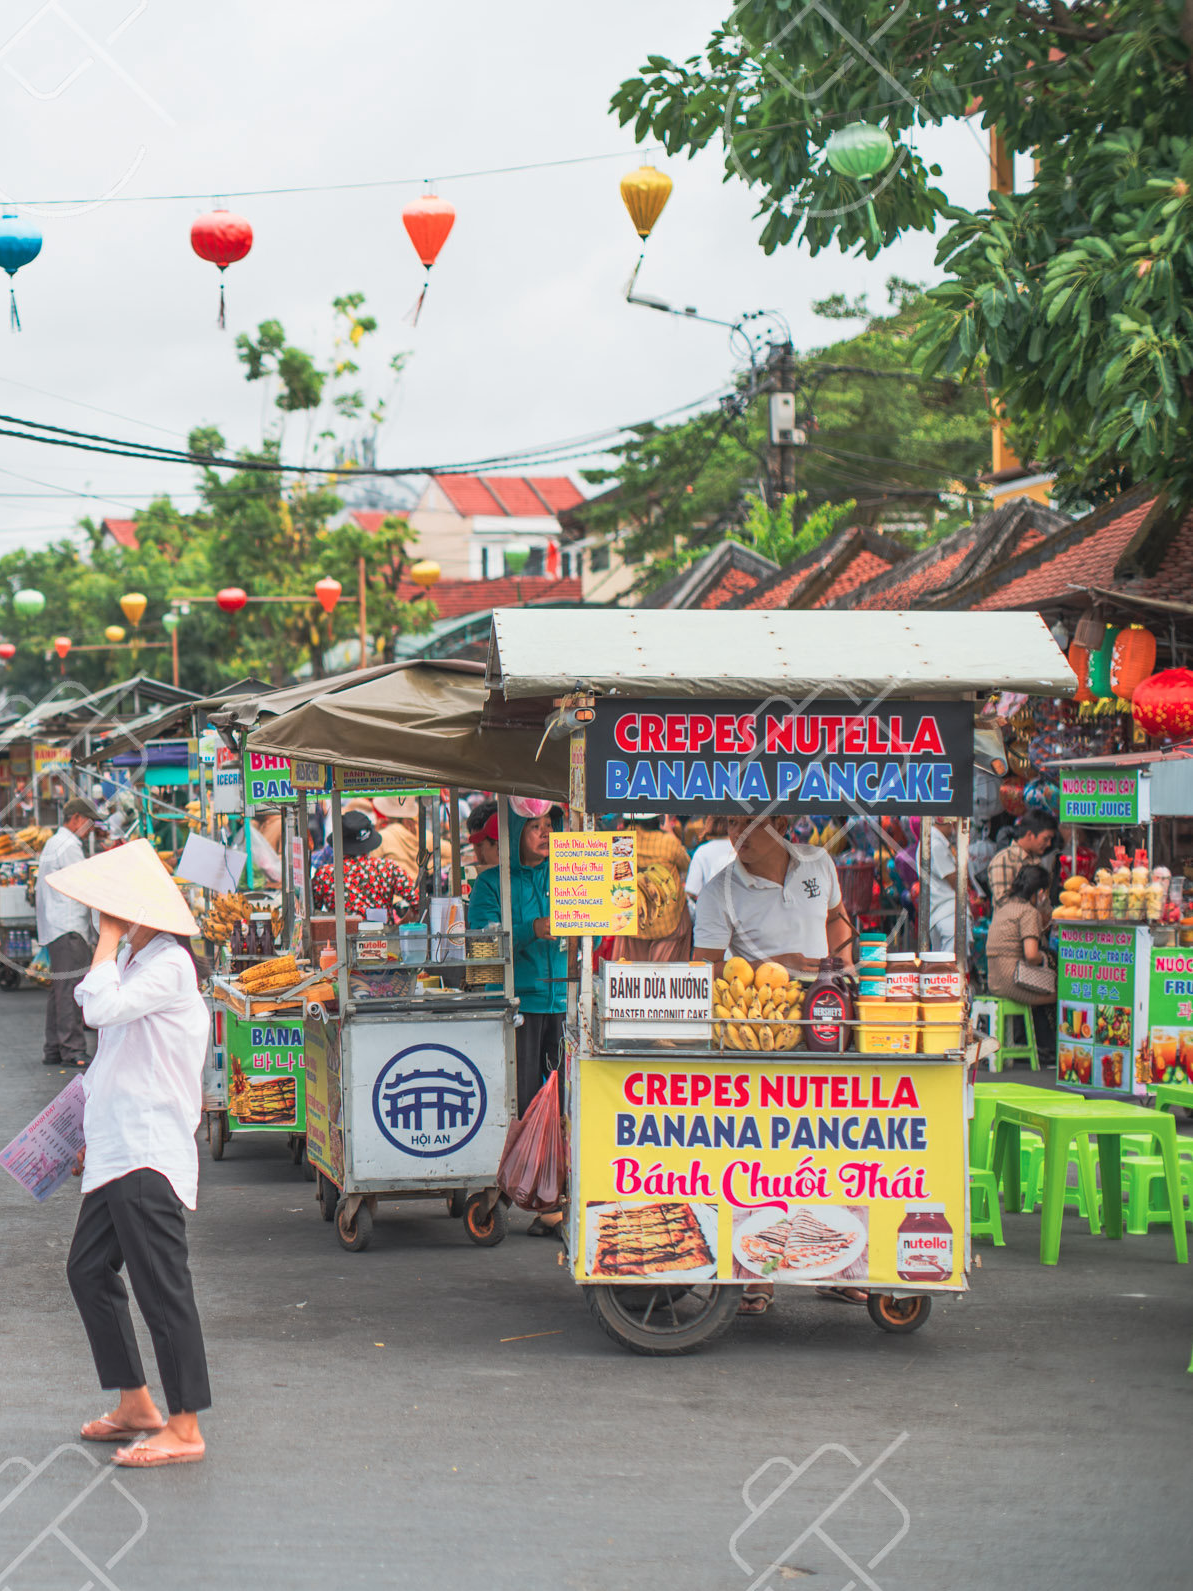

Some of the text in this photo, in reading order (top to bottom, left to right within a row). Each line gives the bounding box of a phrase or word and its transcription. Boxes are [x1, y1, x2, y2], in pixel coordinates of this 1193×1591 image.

[614, 713, 946, 755] CREPES NUTELLA
[606, 760, 771, 800] BANANA
[777, 762, 954, 802] PANCAKE
[1067, 801, 1131, 816] FRUIT JUICE
[553, 839, 570, 849] Bánh
[554, 862, 570, 872] Bánh
[554, 887, 570, 896] Bánh
[554, 910, 570, 920] Bánh
[358, 940, 387, 949] nutella
[887, 972, 919, 985] nutella
[924, 972, 959, 985] nutella
[1065, 963, 1127, 982] FRUIT JUICE
[610, 971, 709, 1000] BÁNH DỪA NƯỚNG
[610, 1008, 708, 1019] TOASTED COCONUT CAKE
[813, 1007, 843, 1017] HERSHEY'S
[623, 1072, 920, 1109] CREPES NUTELLA
[616, 1113, 928, 1150] BANANA PANCAKE
[411, 1132, 451, 1147] HỘI AN
[612, 1156, 930, 1213] Bánh Chuối Thái
[903, 1237, 947, 1249] nutella
